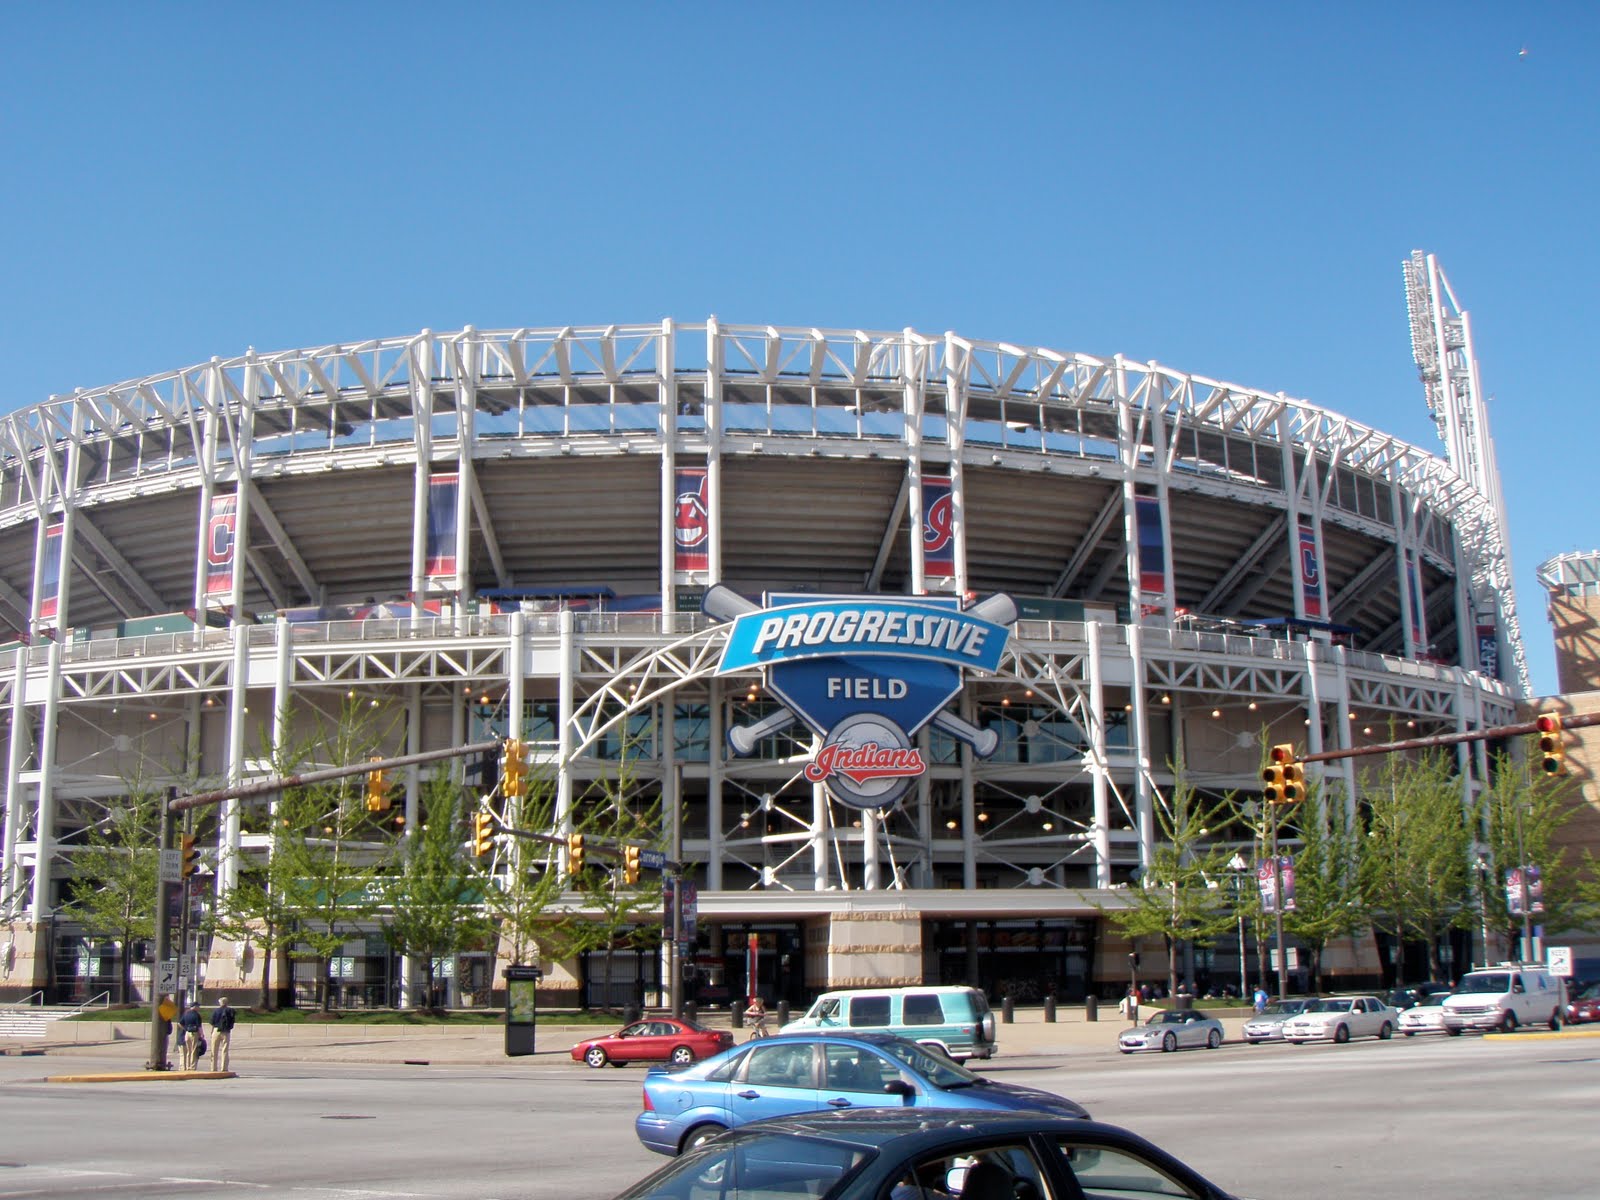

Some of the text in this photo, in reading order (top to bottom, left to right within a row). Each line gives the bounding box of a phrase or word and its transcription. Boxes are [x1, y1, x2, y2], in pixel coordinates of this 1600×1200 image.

[208, 512, 236, 566] C
[1299, 539, 1319, 588] C
[752, 610, 989, 656] PROGRESSIVE
[827, 677, 908, 700] FIELD
[803, 741, 926, 787] Indians
[161, 963, 176, 971] KEEP
[182, 964, 191, 974] 25
[160, 983, 176, 992] RIGHT
